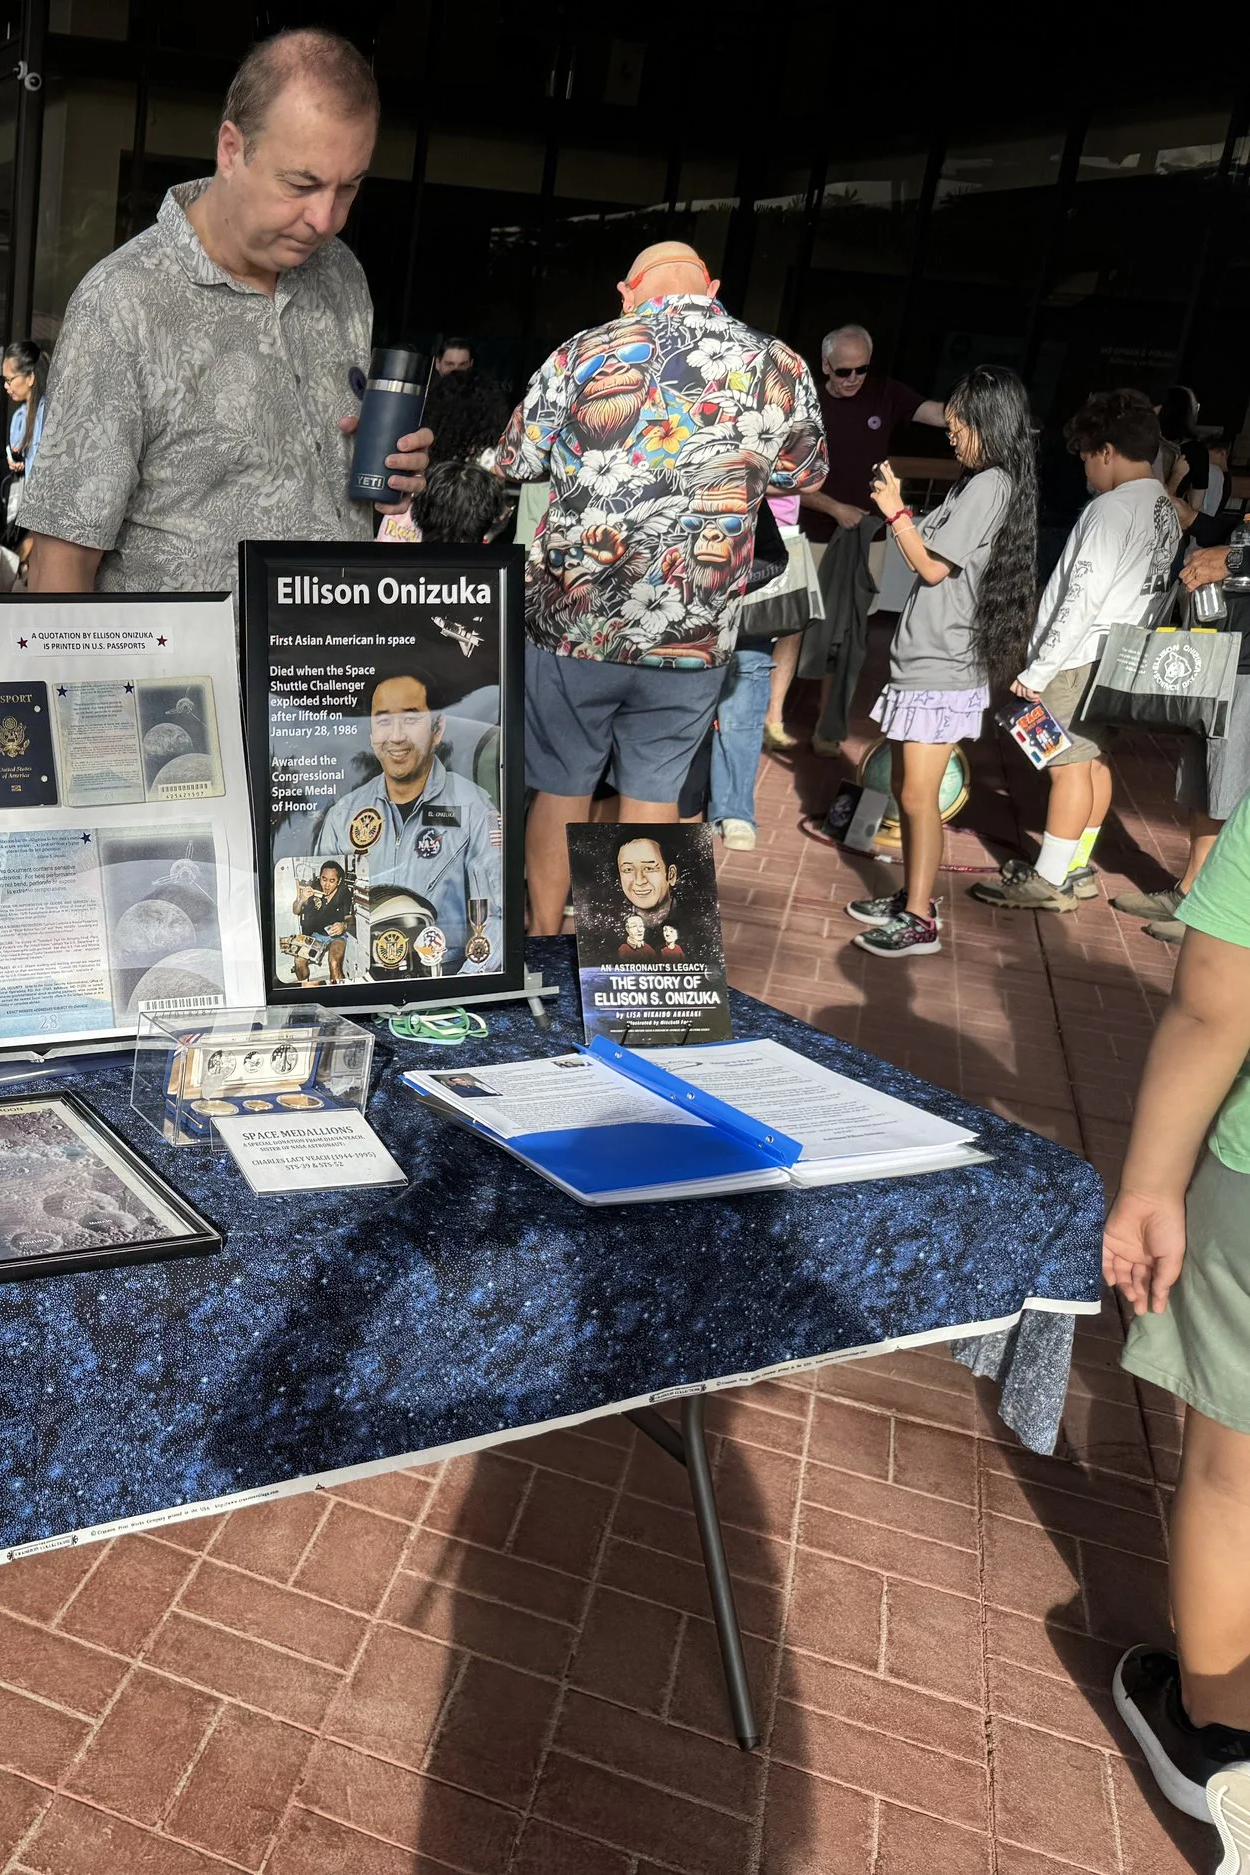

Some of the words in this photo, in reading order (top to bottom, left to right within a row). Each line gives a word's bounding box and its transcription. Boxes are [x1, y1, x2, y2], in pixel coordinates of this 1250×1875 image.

[357, 475, 382, 487] YETI
[277, 576, 370, 605] Ellison
[377, 576, 491, 605] Onizuka
[38, 632, 81, 640] QUOTATION
[92, 631, 120, 639] ELLISON
[122, 631, 153, 639] ONIZUKA
[270, 635, 293, 645] First
[295, 635, 323, 645] Asian
[325, 634, 373, 645] American
[376, 634, 385, 645] in
[387, 635, 416, 646] space
[1152, 644, 1180, 669] ELLISON
[1183, 645, 1202, 672] ONIZUKA
[270, 666, 294, 676] Died
[296, 666, 324, 676] when
[327, 666, 344, 675] the
[346, 666, 376, 677] Space
[270, 681, 308, 691] Shuttle
[310, 680, 365, 693] Challenger
[1153, 673, 1179, 690] SCIENCE
[1182, 675, 1195, 688] DAY
[270, 696, 320, 708] exploded
[322, 695, 358, 707] shortly
[271, 711, 296, 722] after
[299, 711, 328, 721] liftoff
[330, 711, 343, 720] on
[270, 726, 312, 739] January
[314, 726, 330, 736] 28,
[334, 725, 358, 735] 1986
[272, 756, 318, 767] Awarded
[320, 756, 337, 765] the
[272, 770, 345, 783] Congressional
[272, 786, 303, 798] Space
[305, 785, 337, 795] Medal
[272, 802, 283, 812] of
[285, 802, 318, 811] Honor
[600, 964, 611, 972] AN
[615, 964, 670, 972] ASTRONAUT'S
[610, 976, 636, 989] THE
[639, 976, 679, 989] STORY
[684, 976, 701, 989] OF
[595, 992, 648, 1006] ELLISON
[650, 992, 663, 1005] S.
[665, 991, 721, 1004] ONIZUKA
[40, 1014, 59, 1029] 28
[242, 1131, 279, 1141] SPACE
[281, 1126, 354, 1138] MEDALLIONS
[252, 1158, 285, 1166] CHARLES
[330, 1152, 376, 1160] (1944-1995)
